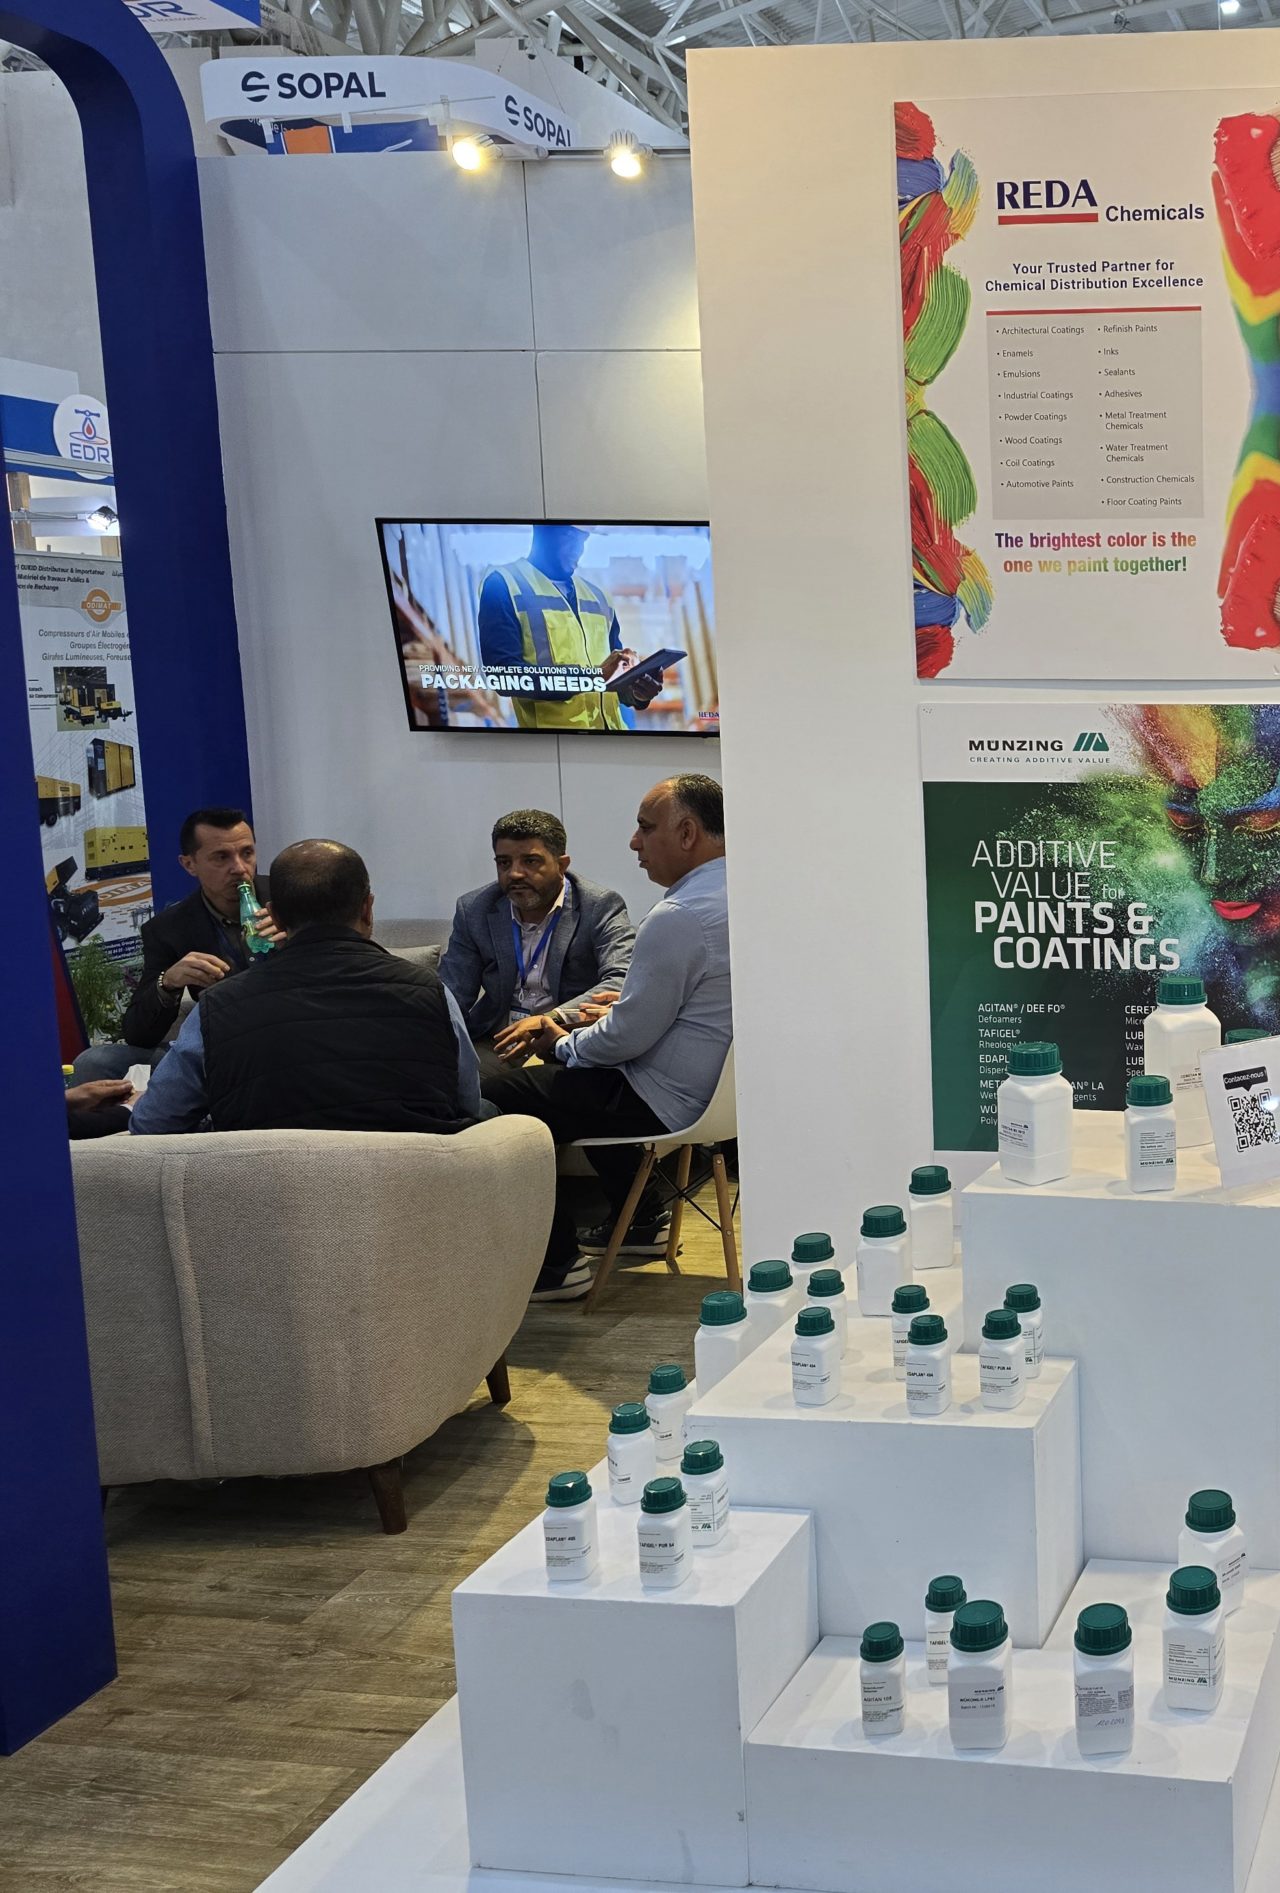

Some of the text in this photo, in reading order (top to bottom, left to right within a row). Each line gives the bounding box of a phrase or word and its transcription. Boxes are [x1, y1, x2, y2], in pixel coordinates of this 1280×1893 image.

[277, 71, 386, 99] SOPAL
[997, 179, 1097, 209] REDA
[1105, 204, 1204, 222] Chemicals
[1013, 258, 1175, 275] Your Trusted Partner for
[985, 275, 1203, 292] Chemical Distribution Excellence
[1002, 325, 1085, 336] Architectural Coatings
[1103, 324, 1157, 333] Refinish Paints
[1003, 349, 1033, 357] Enamels
[1104, 347, 1119, 355] Inks
[1003, 370, 1040, 379] Emulsions
[1104, 368, 1135, 376] Sealants
[1004, 390, 1073, 401] Industrial Coatings
[1105, 389, 1142, 398] Adhesives
[1005, 412, 1067, 423] Powder Coatings
[1105, 411, 1167, 420] Metal Treatment
[1106, 421, 1143, 431] Chemicals
[1005, 435, 1062, 446] Wood Coatings
[1106, 442, 1168, 452] Water Treatment
[1006, 458, 1055, 468] Coil Coatings
[1106, 454, 1144, 463] Chemicals
[1007, 479, 1074, 488] Automotive Paints
[1107, 474, 1194, 484] Construction Chemicals
[1107, 497, 1182, 507] Floor Coating Paints
[995, 531, 1196, 552] The brightest color is the
[1004, 556, 1187, 576] one we paint together!
[39, 629, 85, 638] Compresseurs
[70, 642, 96, 650] Groupes
[42, 653, 105, 661] Girafes Lumineuses,
[419, 665, 460, 673] PROVIDING
[482, 666, 522, 674] COMPLETE
[524, 666, 567, 675] SOLUTIONS
[581, 667, 603, 675] YOUR
[421, 674, 606, 692] PACKAGING NEEDS
[970, 756, 1020, 764] CREATING
[1026, 756, 1073, 764] ADDITIVE
[972, 840, 1116, 868] ADDITIVE
[992, 872, 1124, 899] VALUE for
[975, 902, 1153, 934] PAINTS &
[993, 937, 1180, 970] COATINGS
[1021, 1004, 1024, 1014] /
[1027, 1004, 1044, 1013] DEE
[978, 1015, 1022, 1023] Defoamers
